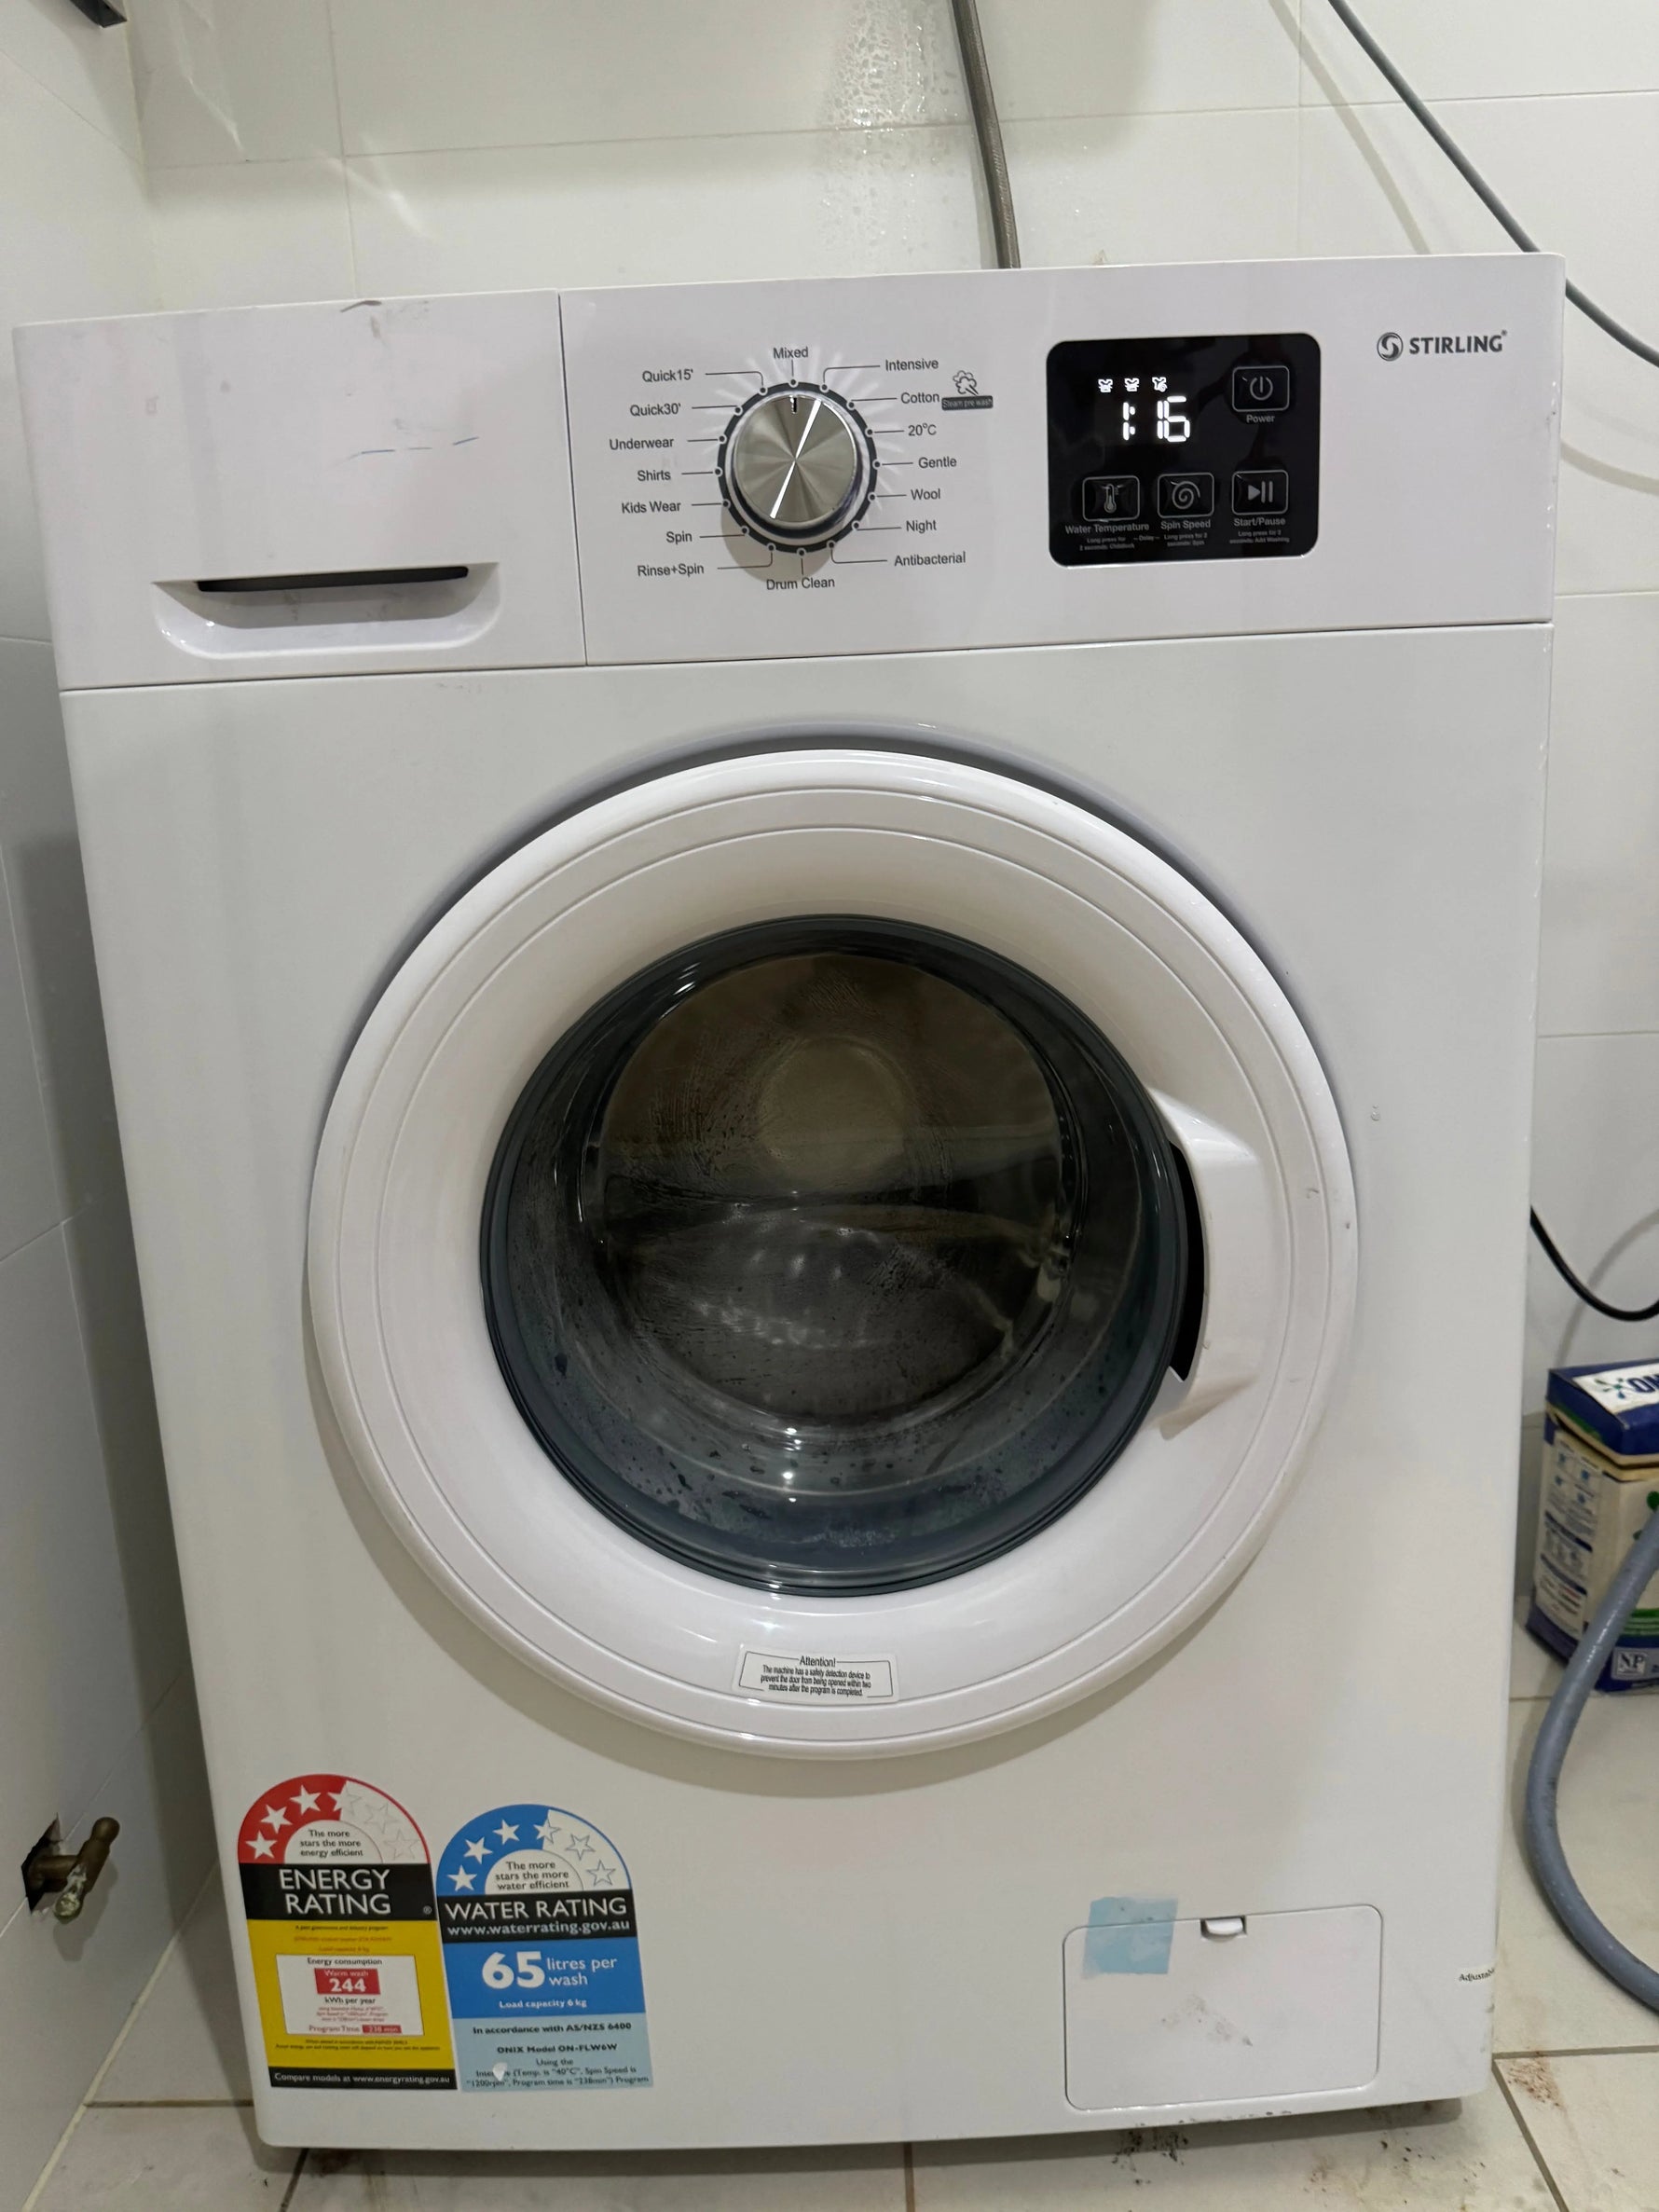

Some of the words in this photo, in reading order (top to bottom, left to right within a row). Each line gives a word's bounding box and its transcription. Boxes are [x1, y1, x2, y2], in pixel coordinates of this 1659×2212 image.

[1408, 335, 1503, 355] STIRLING
[773, 347, 809, 360] Mixed
[884, 358, 939, 372] Intensive
[642, 368, 694, 383] Quick15'
[900, 392, 940, 405] Cotton
[629, 403, 681, 417] Quick30'
[1122, 395, 1190, 442] 1:16
[1246, 414, 1275, 423] Power
[908, 422, 937, 436] 20°C
[609, 437, 675, 451] Underwear
[918, 456, 957, 469] Gentle
[637, 470, 671, 482] Shirts
[910, 488, 941, 501] Wool
[621, 501, 647, 514] Kids
[650, 501, 681, 513] Wear
[905, 519, 938, 534] Night
[1064, 525, 1090, 534] Water
[1093, 523, 1150, 534] Temperature
[1160, 520, 1182, 531] Spin
[1184, 518, 1212, 530] Speed
[1233, 517, 1286, 527] Start/Pause
[666, 530, 692, 545] Spin
[894, 550, 967, 567] Antibacterial
[637, 563, 705, 577] Rinse+Spin
[766, 578, 798, 591] Drum
[802, 577, 835, 590] Clean
[799, 1656, 836, 1668] Attention!
[762, 1664, 773, 1673] The
[774, 1666, 794, 1675] machine
[795, 1667, 804, 1676] has
[809, 1668, 824, 1678] safety
[825, 1669, 848, 1678] detection
[848, 1670, 865, 1680] device
[865, 1671, 871, 1680] to
[761, 1675, 779, 1684] prevent
[780, 1674, 788, 1683] the
[801, 1676, 813, 1684] from
[813, 1677, 828, 1687] being
[828, 1679, 846, 1688] opened
[847, 1679, 862, 1688] within
[862, 1681, 872, 1689] two
[769, 1683, 788, 1692] minutes
[788, 1684, 801, 1693] after
[810, 1686, 831, 1696] program
[308, 1829, 325, 1837] The
[300, 1850, 328, 1859] energy
[330, 1848, 363, 1857] efficient
[506, 1861, 526, 1870] The
[279, 1868, 391, 1890] ENERGY
[496, 1873, 519, 1881] stars
[542, 1871, 569, 1879] more
[529, 1880, 569, 1889] efficient
[284, 1893, 391, 1915] RATING
[445, 1901, 529, 1921] WATER
[536, 1897, 627, 1917] RATING
[447, 1920, 630, 1936] www.waterrating.gov.au
[308, 1958, 332, 1966] Energy
[324, 1969, 348, 1977] Warm
[481, 1951, 545, 1989] 65
[546, 1958, 585, 1971] litres
[591, 1958, 617, 1972] per
[549, 1972, 588, 1985] wash
[329, 1978, 366, 1993] 244
[499, 2000, 524, 2009] Load
[526, 1999, 565, 2010] capacity
[575, 1999, 587, 2008] kg
[485, 2026, 540, 2034] accordance
[566, 2023, 605, 2032] AS/NZS
[608, 2022, 632, 2030] 6400
[527, 2045, 555, 2054] Model
[557, 2043, 618, 2053] ON-FLW6W
[536, 2057, 558, 2067] Using
[560, 2057, 574, 2066] the
[275, 2072, 310, 2082] Compare
[312, 2073, 341, 2081] models
[353, 2074, 450, 2084] www.energyrating.gov.au
[543, 2068, 550, 2077] is
[585, 2067, 602, 2075] Spin
[603, 2067, 629, 2075] Speed
[513, 2079, 546, 2087] Program
[615, 2075, 649, 2085] Program
